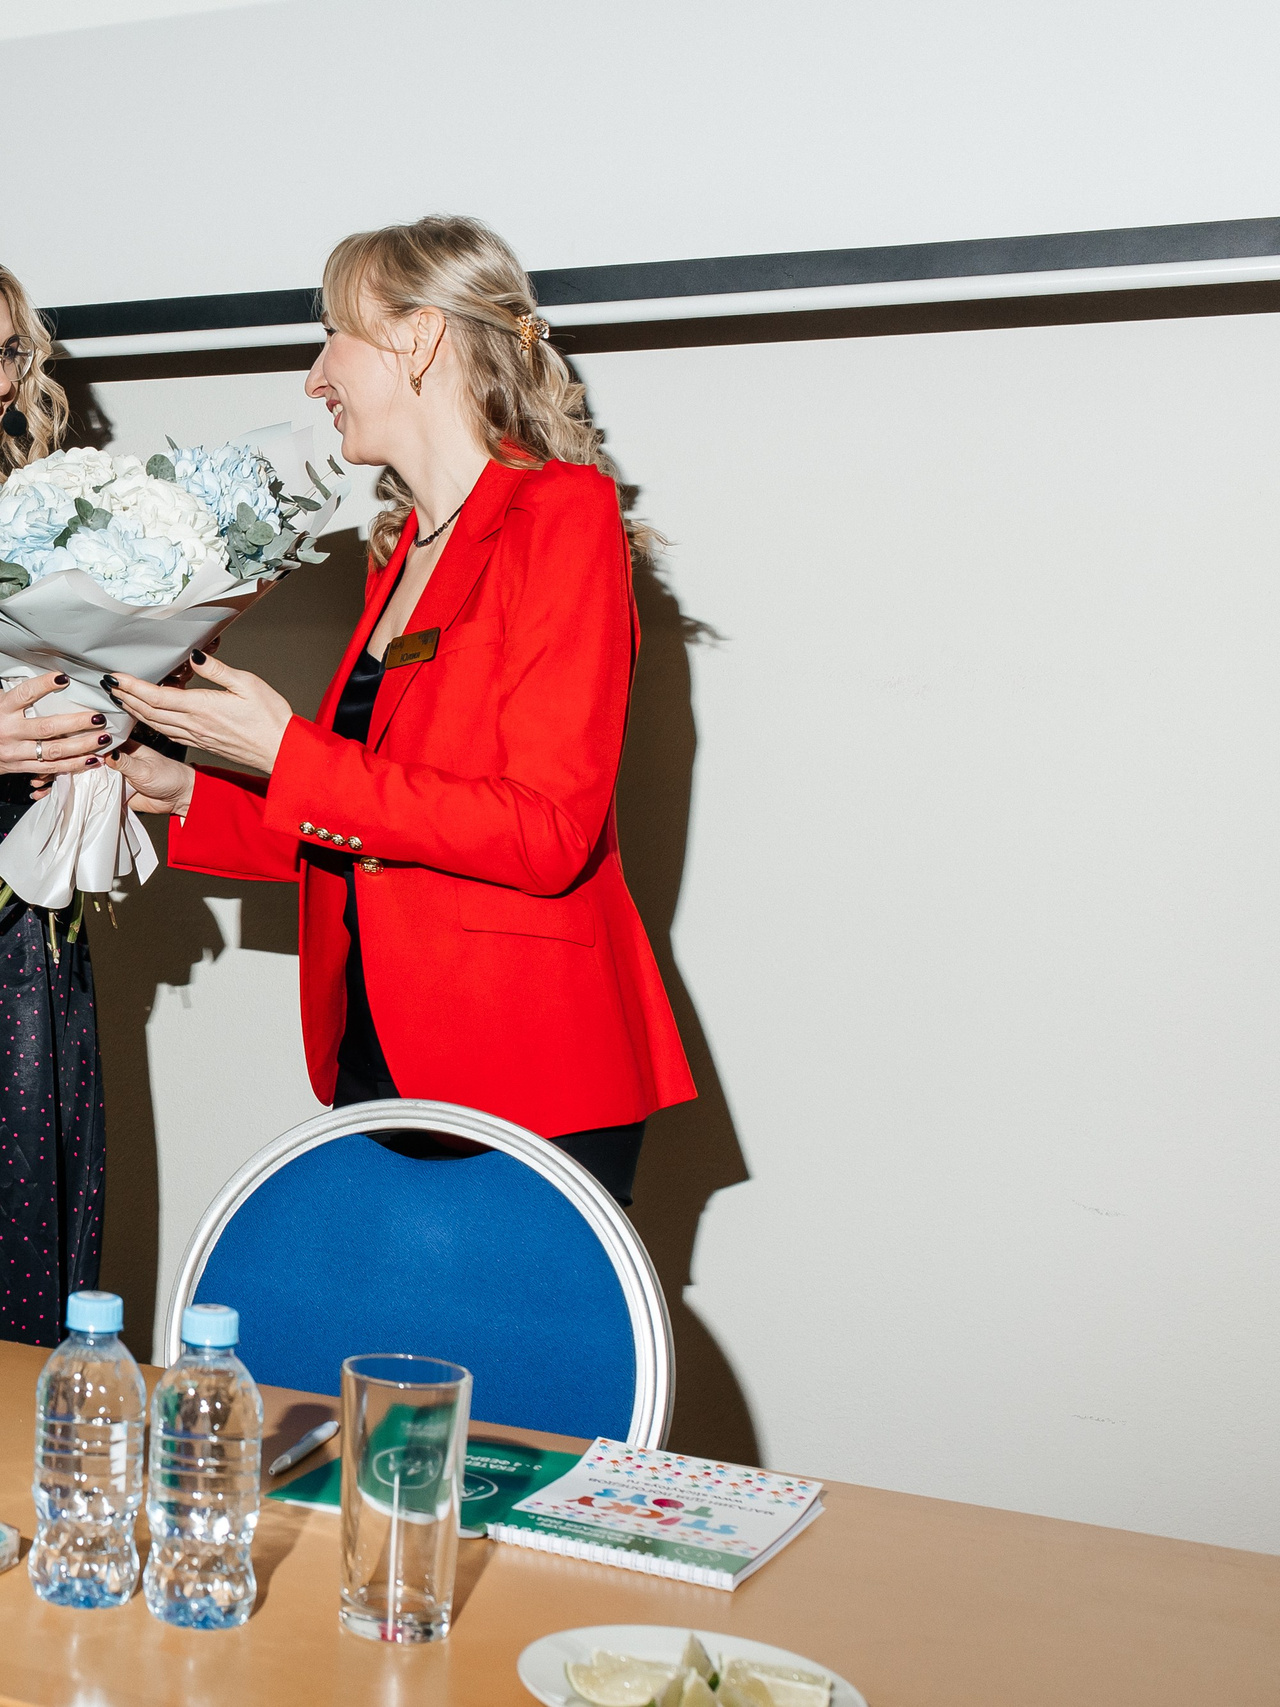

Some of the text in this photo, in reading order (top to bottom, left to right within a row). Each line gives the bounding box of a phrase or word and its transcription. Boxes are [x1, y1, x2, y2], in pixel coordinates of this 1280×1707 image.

[464, 1460, 517, 1472] ЕКАТЕР
[626, 1479, 743, 1504] www.stickytoys.ru
[676, 1494, 707, 1503] ДЛЯ
[593, 1488, 714, 1518] TOYS
[708, 1500, 776, 1516] МАГАЗИН
[564, 1495, 739, 1535] STICKY
